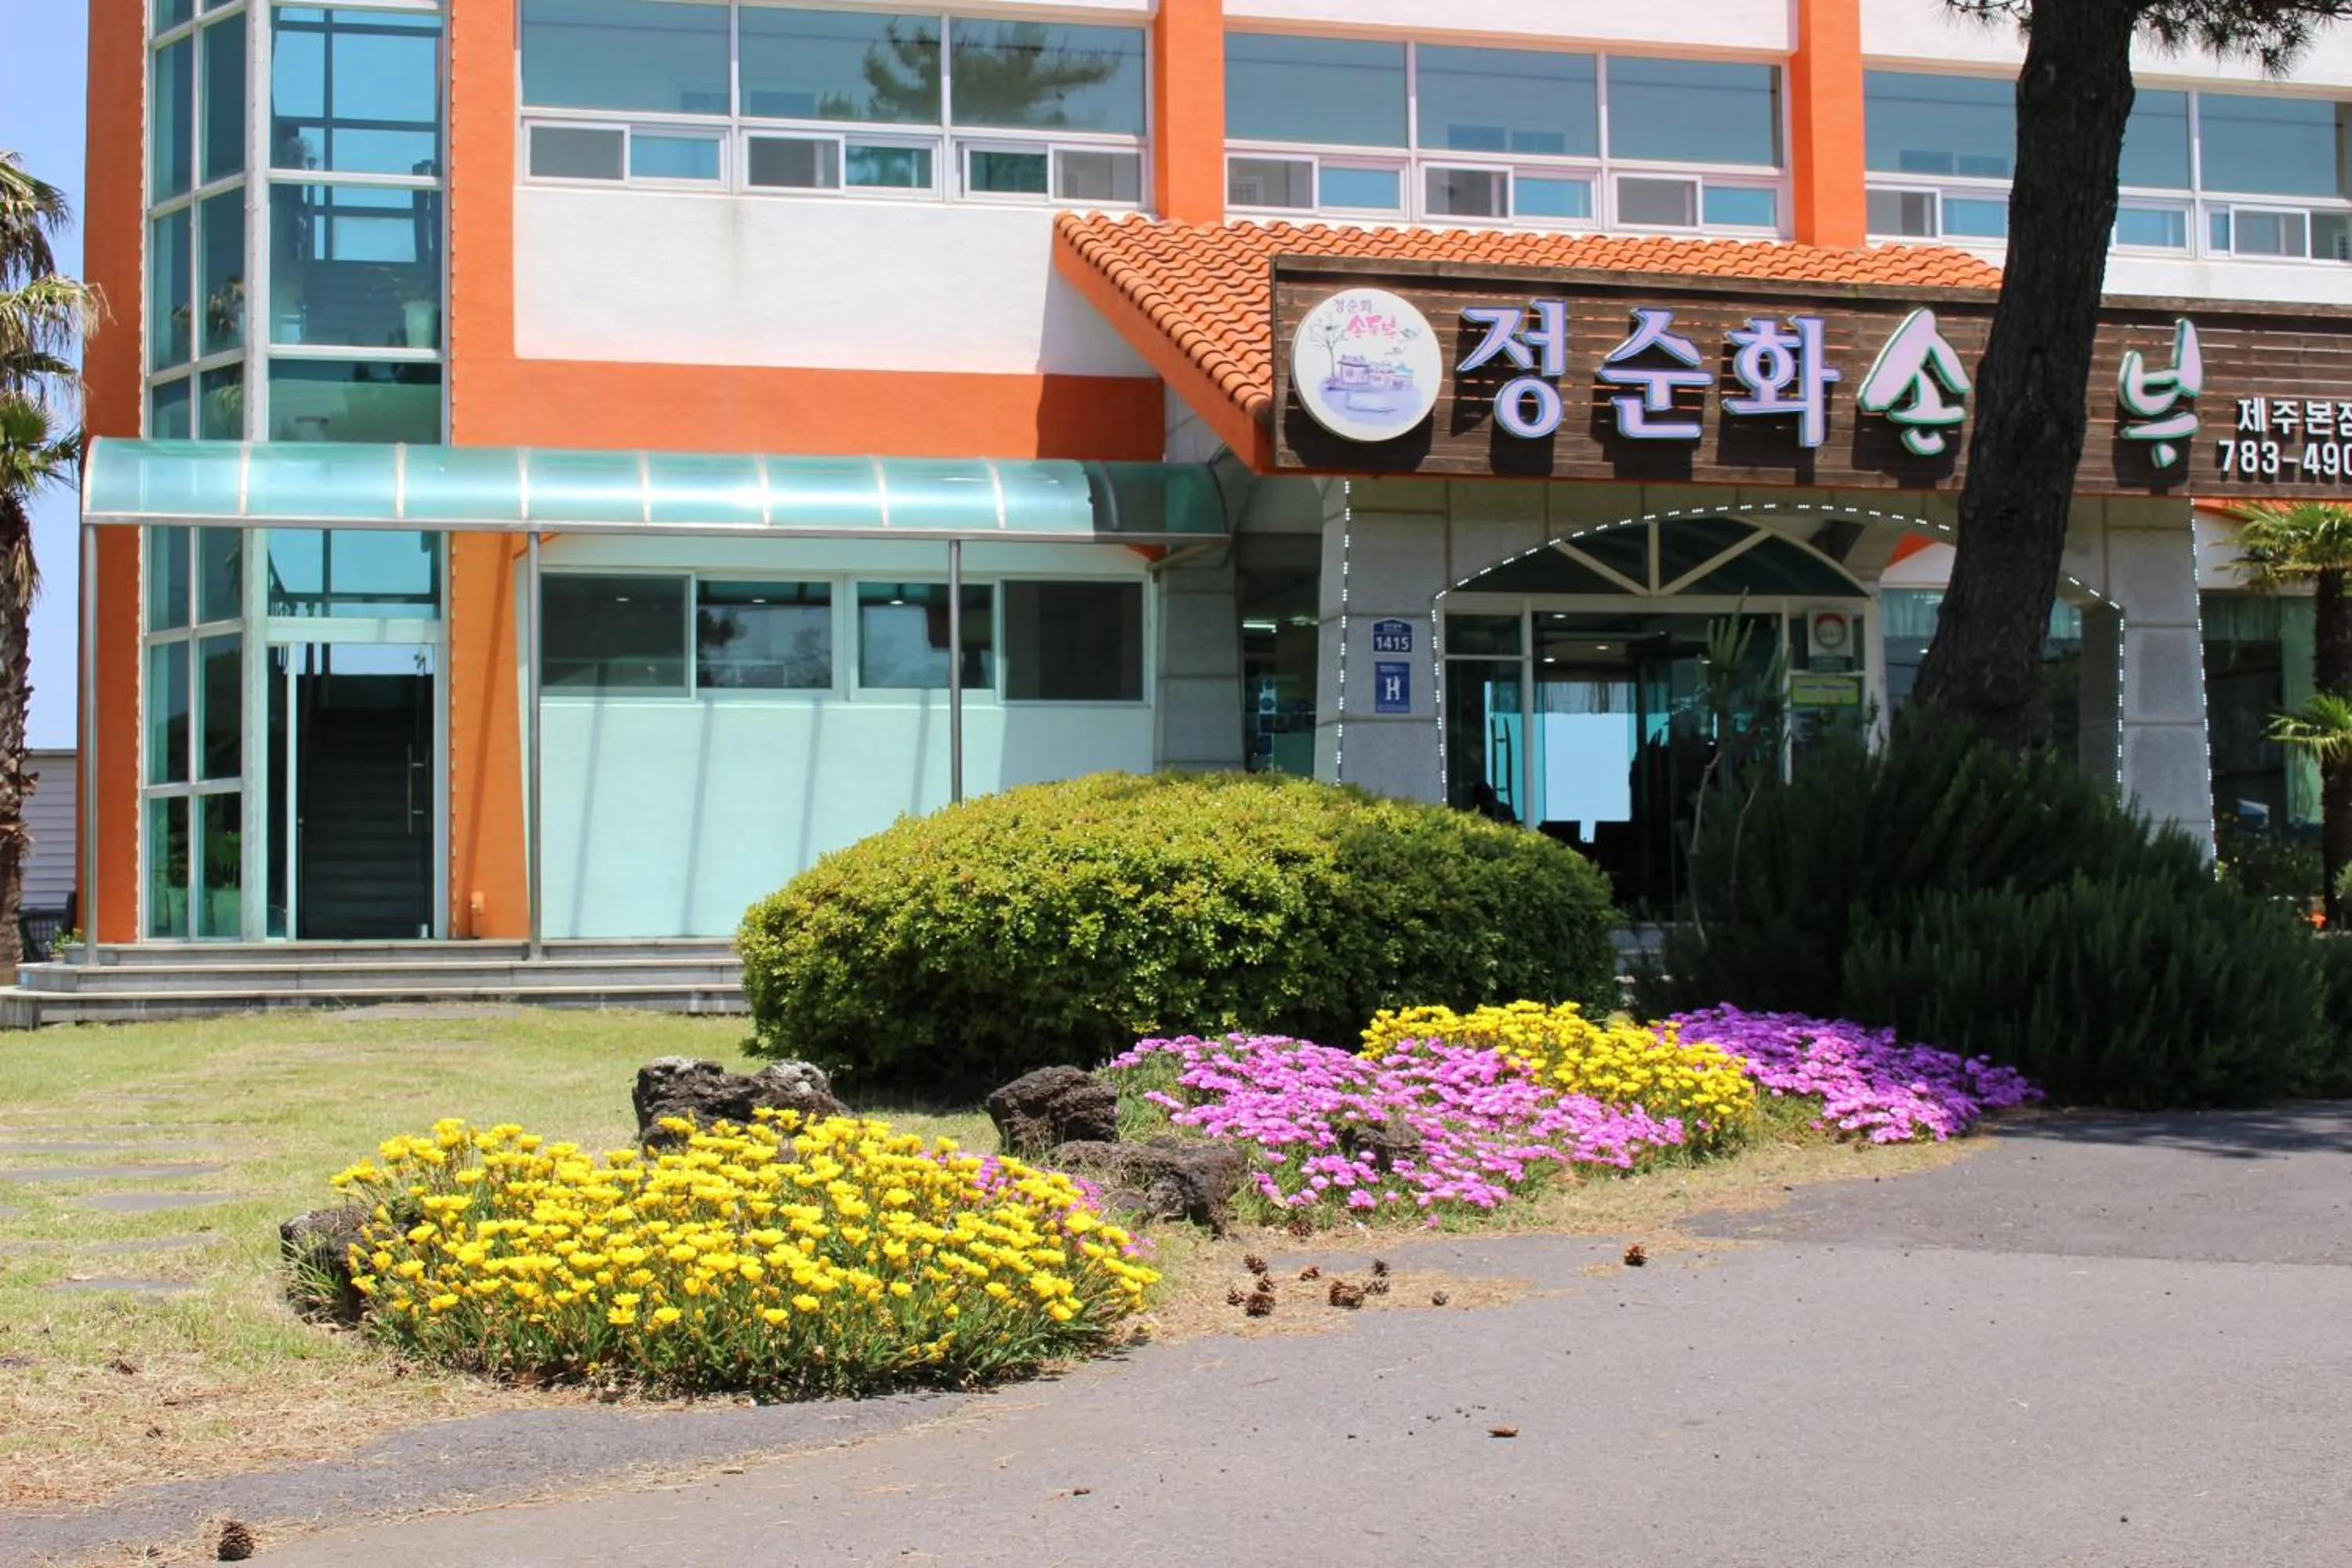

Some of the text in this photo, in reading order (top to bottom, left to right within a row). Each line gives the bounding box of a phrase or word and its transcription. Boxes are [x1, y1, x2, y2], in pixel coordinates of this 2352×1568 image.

[1457, 299, 2203, 469] 정순화 손부
[1376, 636, 1409, 651] 1415
